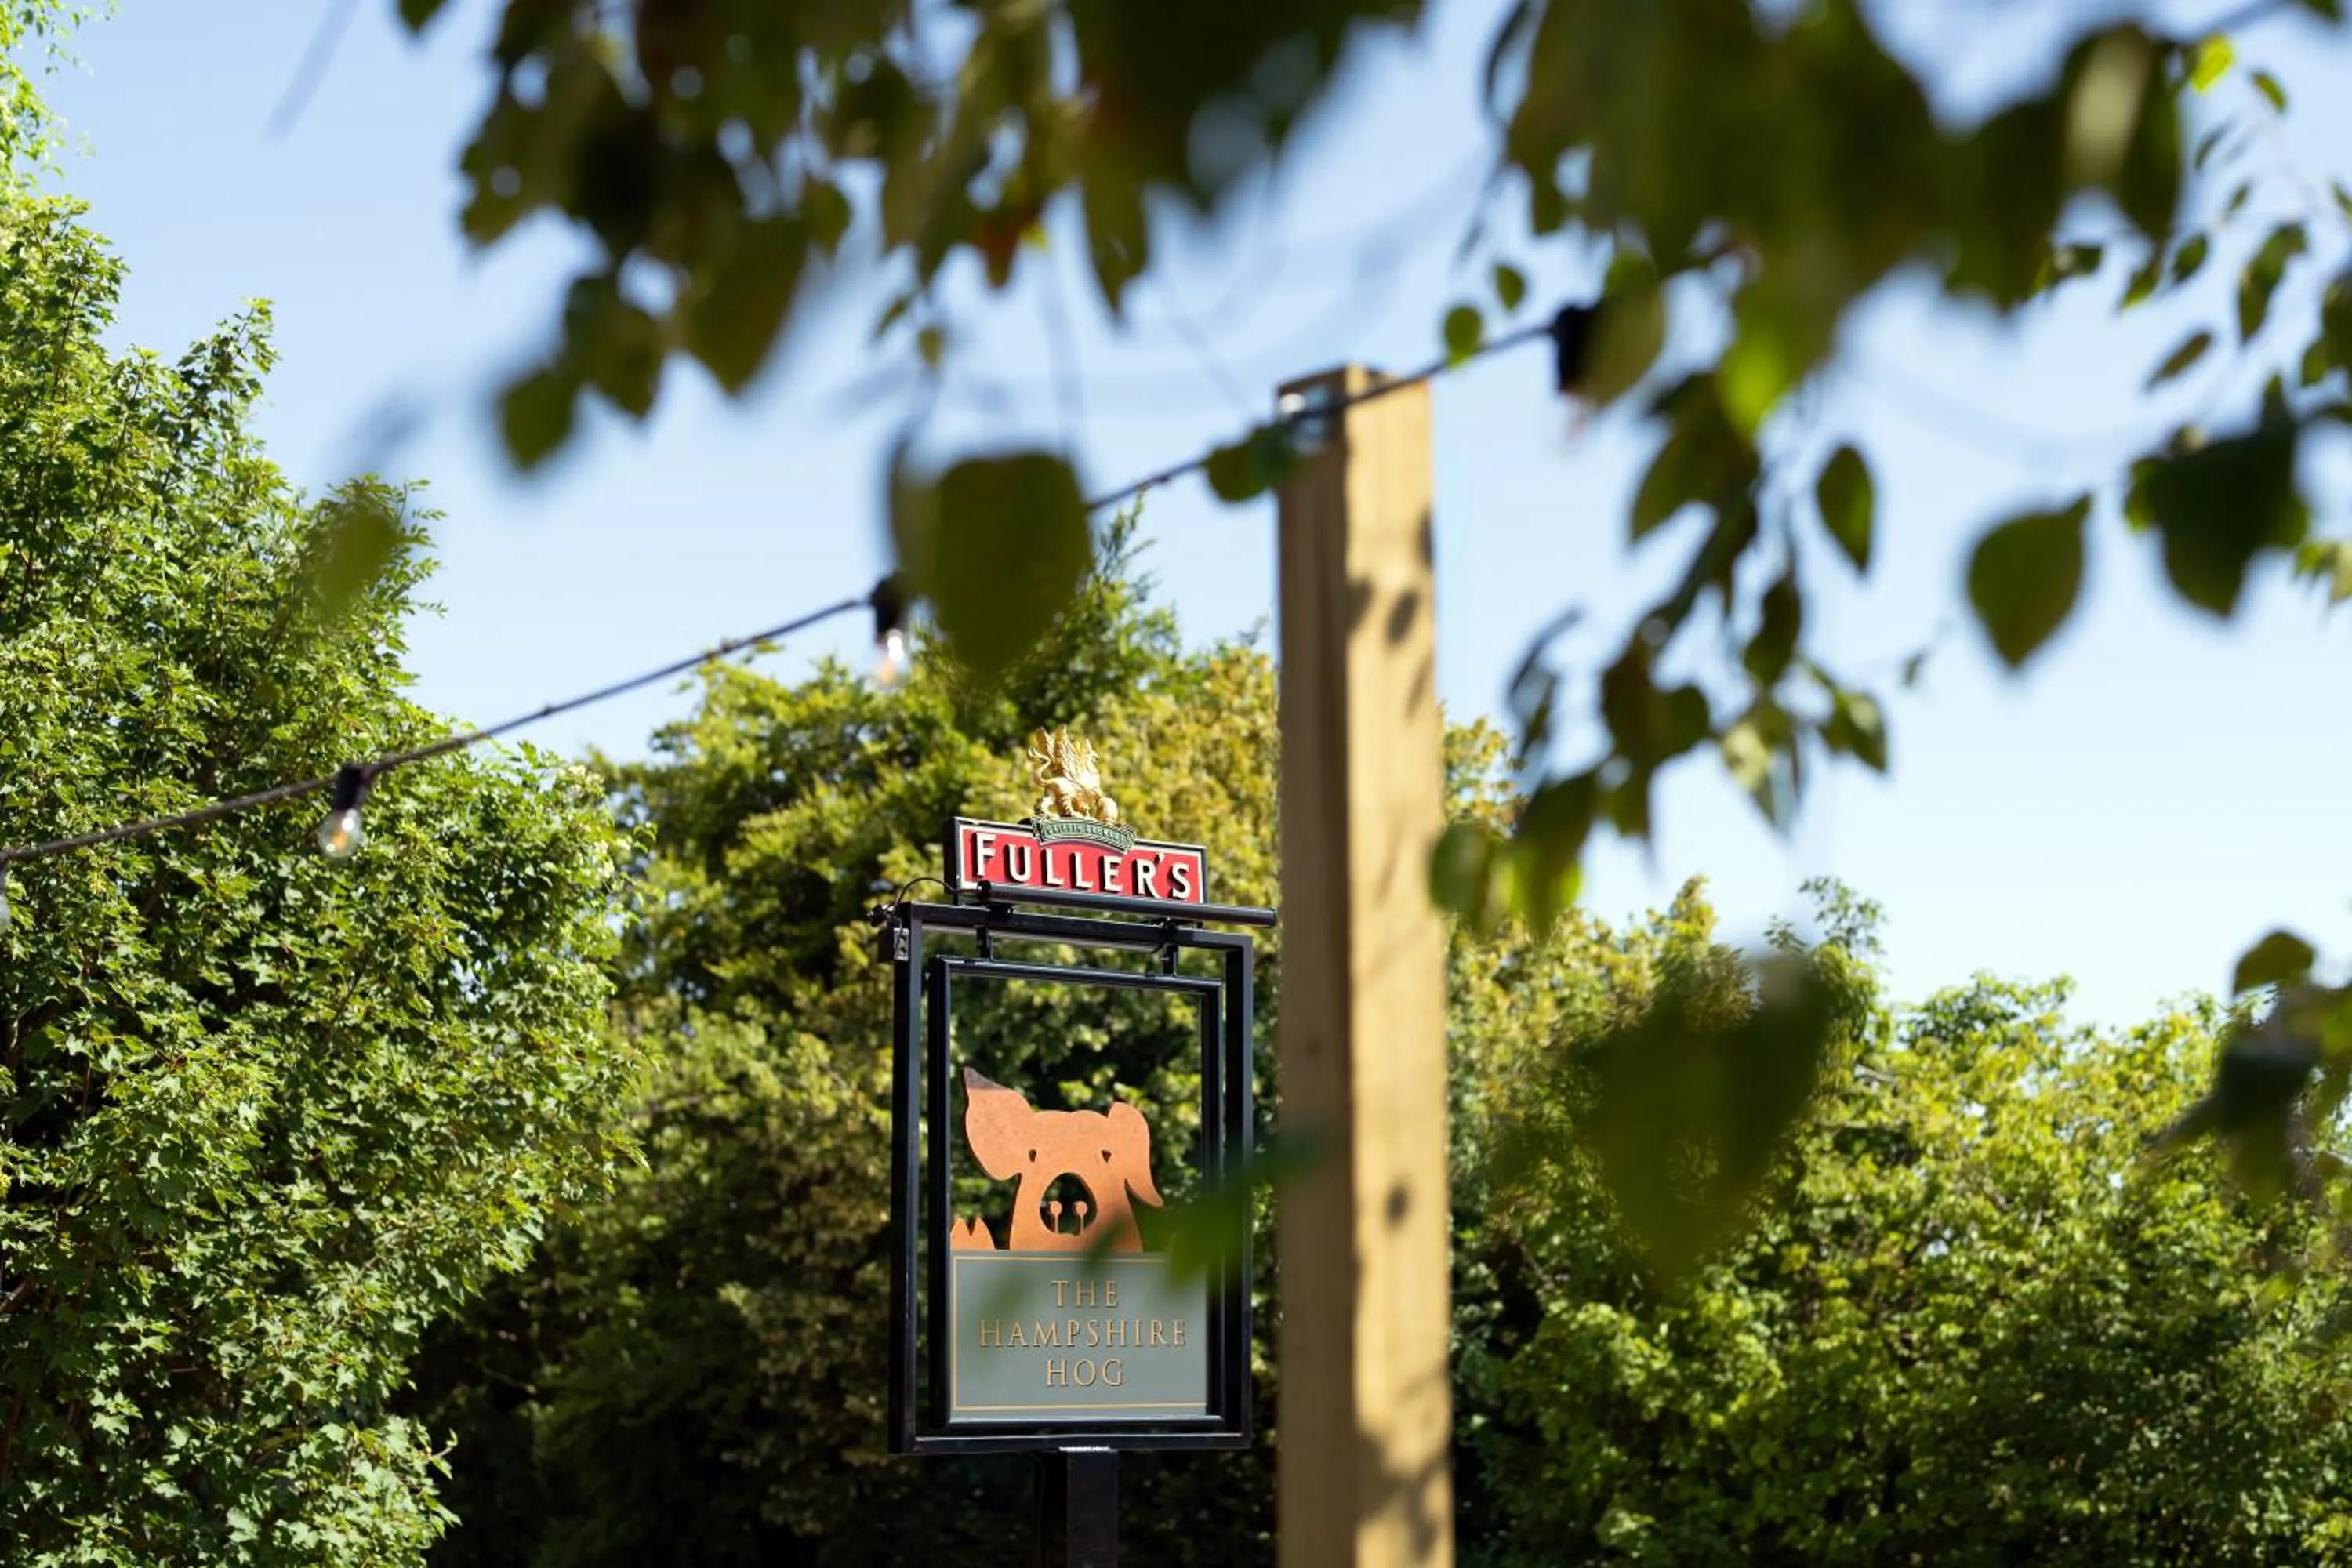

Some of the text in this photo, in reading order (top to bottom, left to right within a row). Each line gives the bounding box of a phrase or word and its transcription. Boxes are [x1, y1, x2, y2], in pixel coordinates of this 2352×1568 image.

[975, 832, 1191, 900] FULLER'S
[1051, 1279, 1120, 1308] THE
[980, 1319, 1186, 1348] HAMPSHIRE
[1045, 1359, 1124, 1387] HOG
